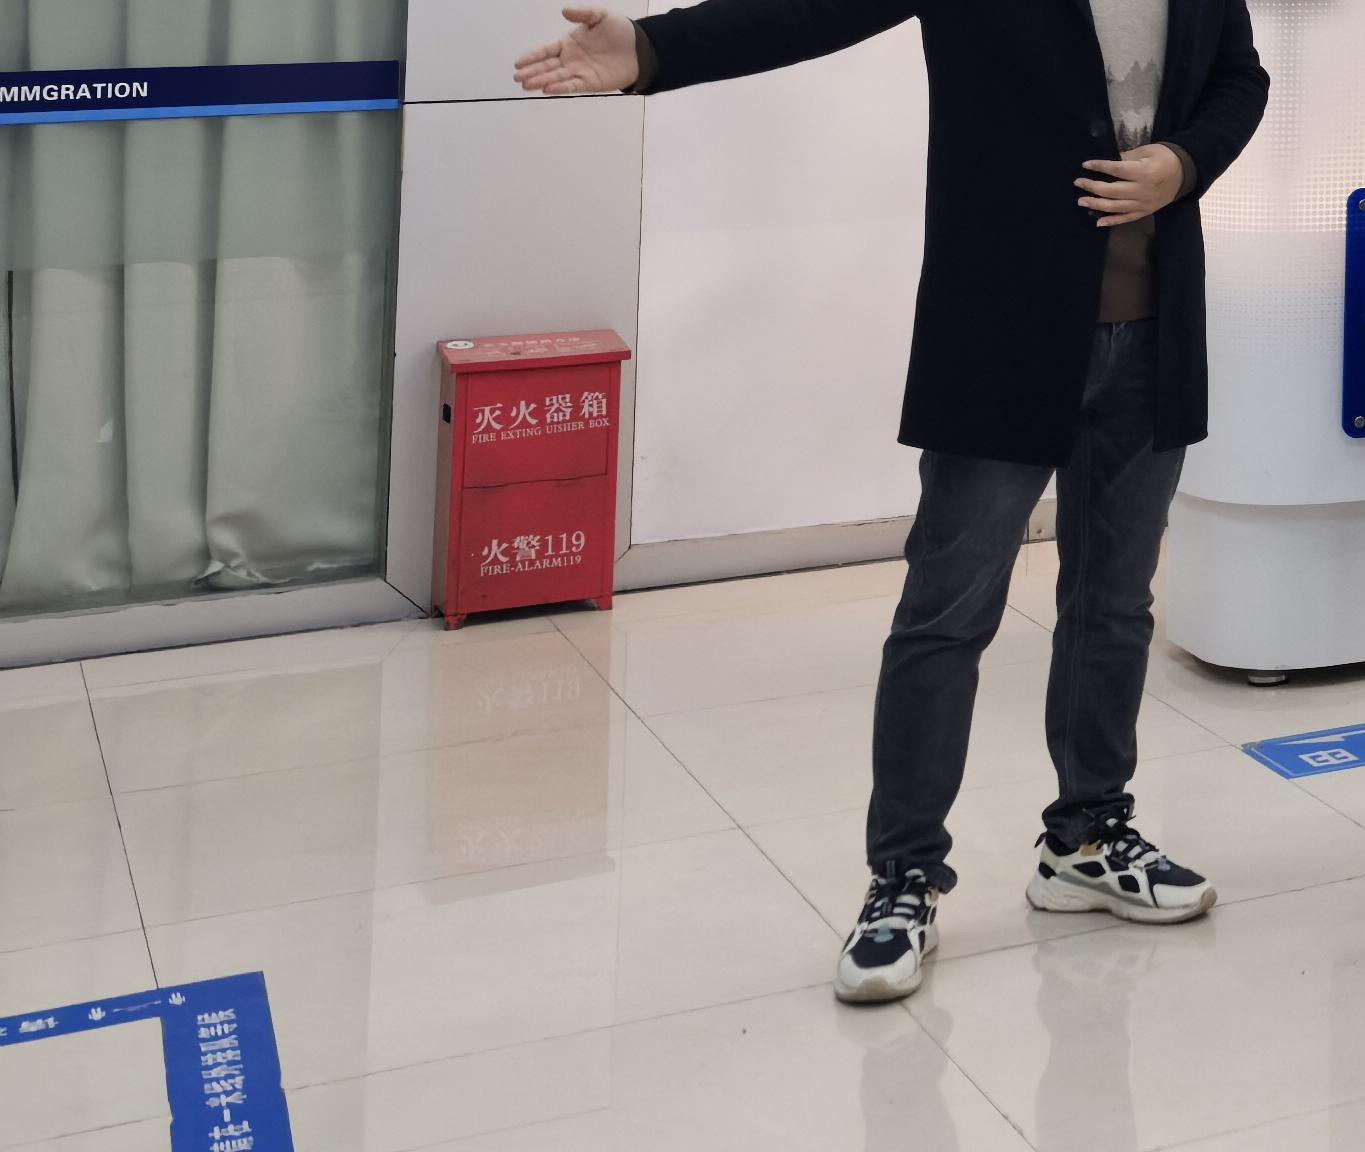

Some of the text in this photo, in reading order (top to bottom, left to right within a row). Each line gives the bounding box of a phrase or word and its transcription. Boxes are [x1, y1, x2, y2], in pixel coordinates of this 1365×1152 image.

[473, 391, 608, 435] 灭火器箱
[472, 417, 611, 444] FIRE EXTING UISHER BOX
[480, 530, 586, 565] 火警119
[480, 554, 582, 577] FIRE-ALARM119
